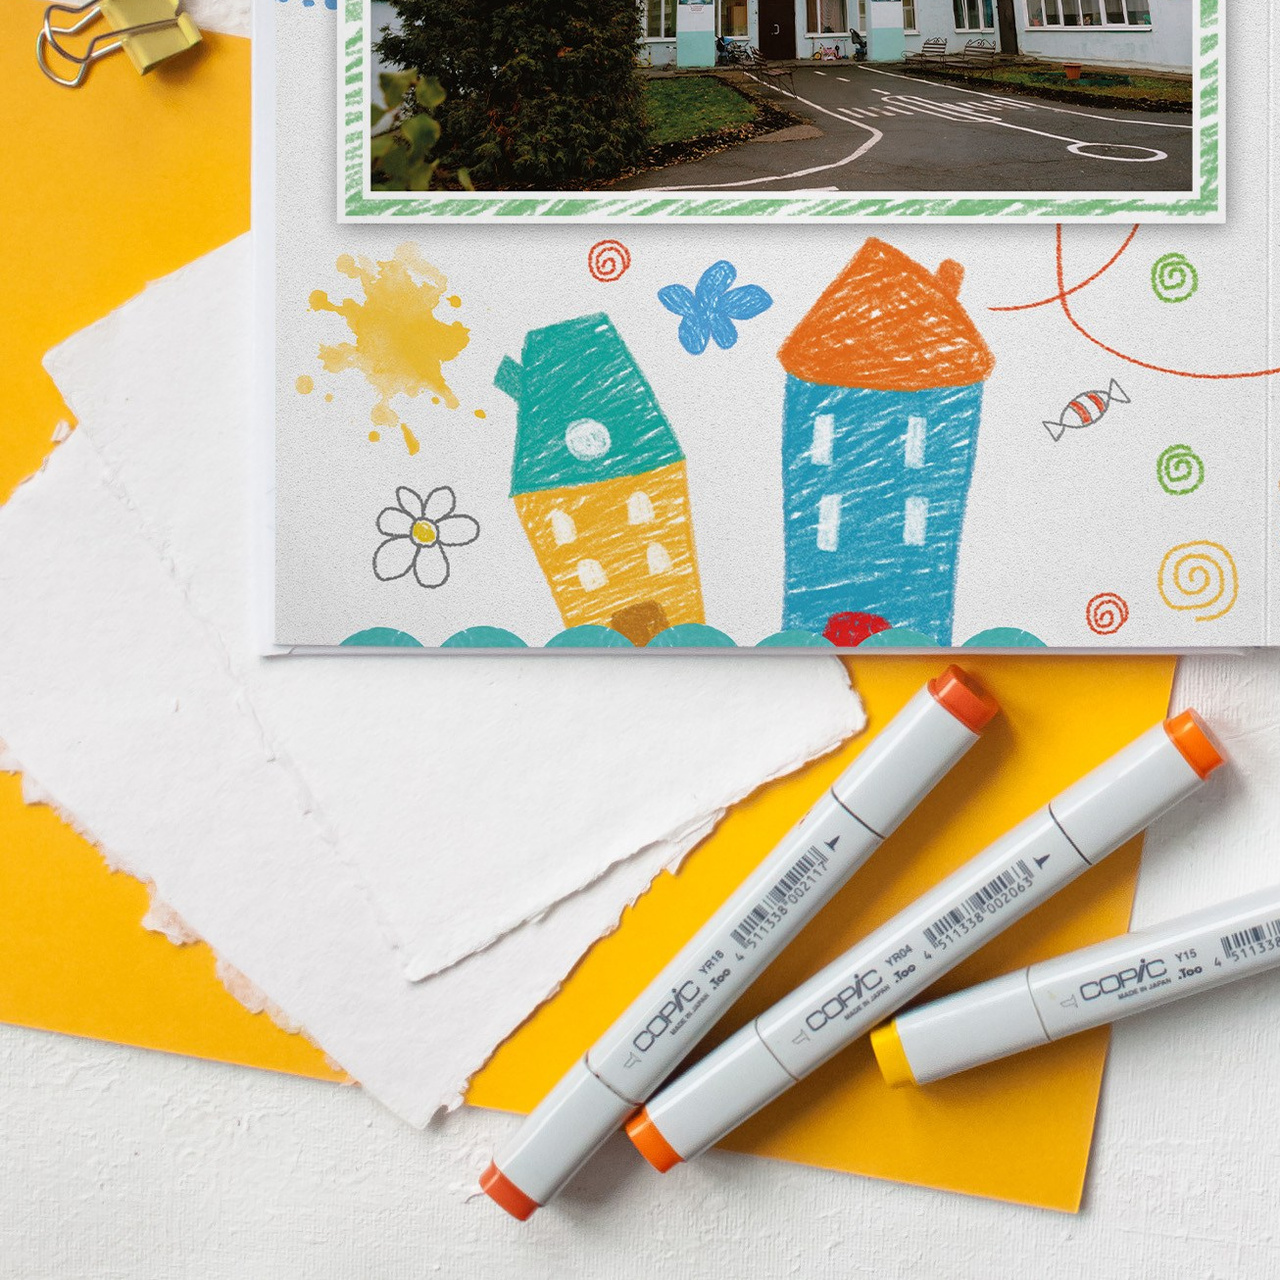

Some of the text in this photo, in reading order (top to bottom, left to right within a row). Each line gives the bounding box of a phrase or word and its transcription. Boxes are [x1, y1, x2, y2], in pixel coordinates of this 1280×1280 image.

[698, 949, 725, 975] YR18
[735, 952, 744, 962] 4
[885, 943, 913, 967] YR04
[923, 950, 932, 960] 4
[1174, 948, 1198, 963] Y15
[1214, 957, 1222, 968] 4
[1118, 977, 1172, 1000] MADE IN JAPAN
[844, 1004, 863, 1021] MADE
[869, 984, 890, 1004] JAPAN
[669, 1017, 687, 1036] MADE
[691, 993, 710, 1014] JAPAN
